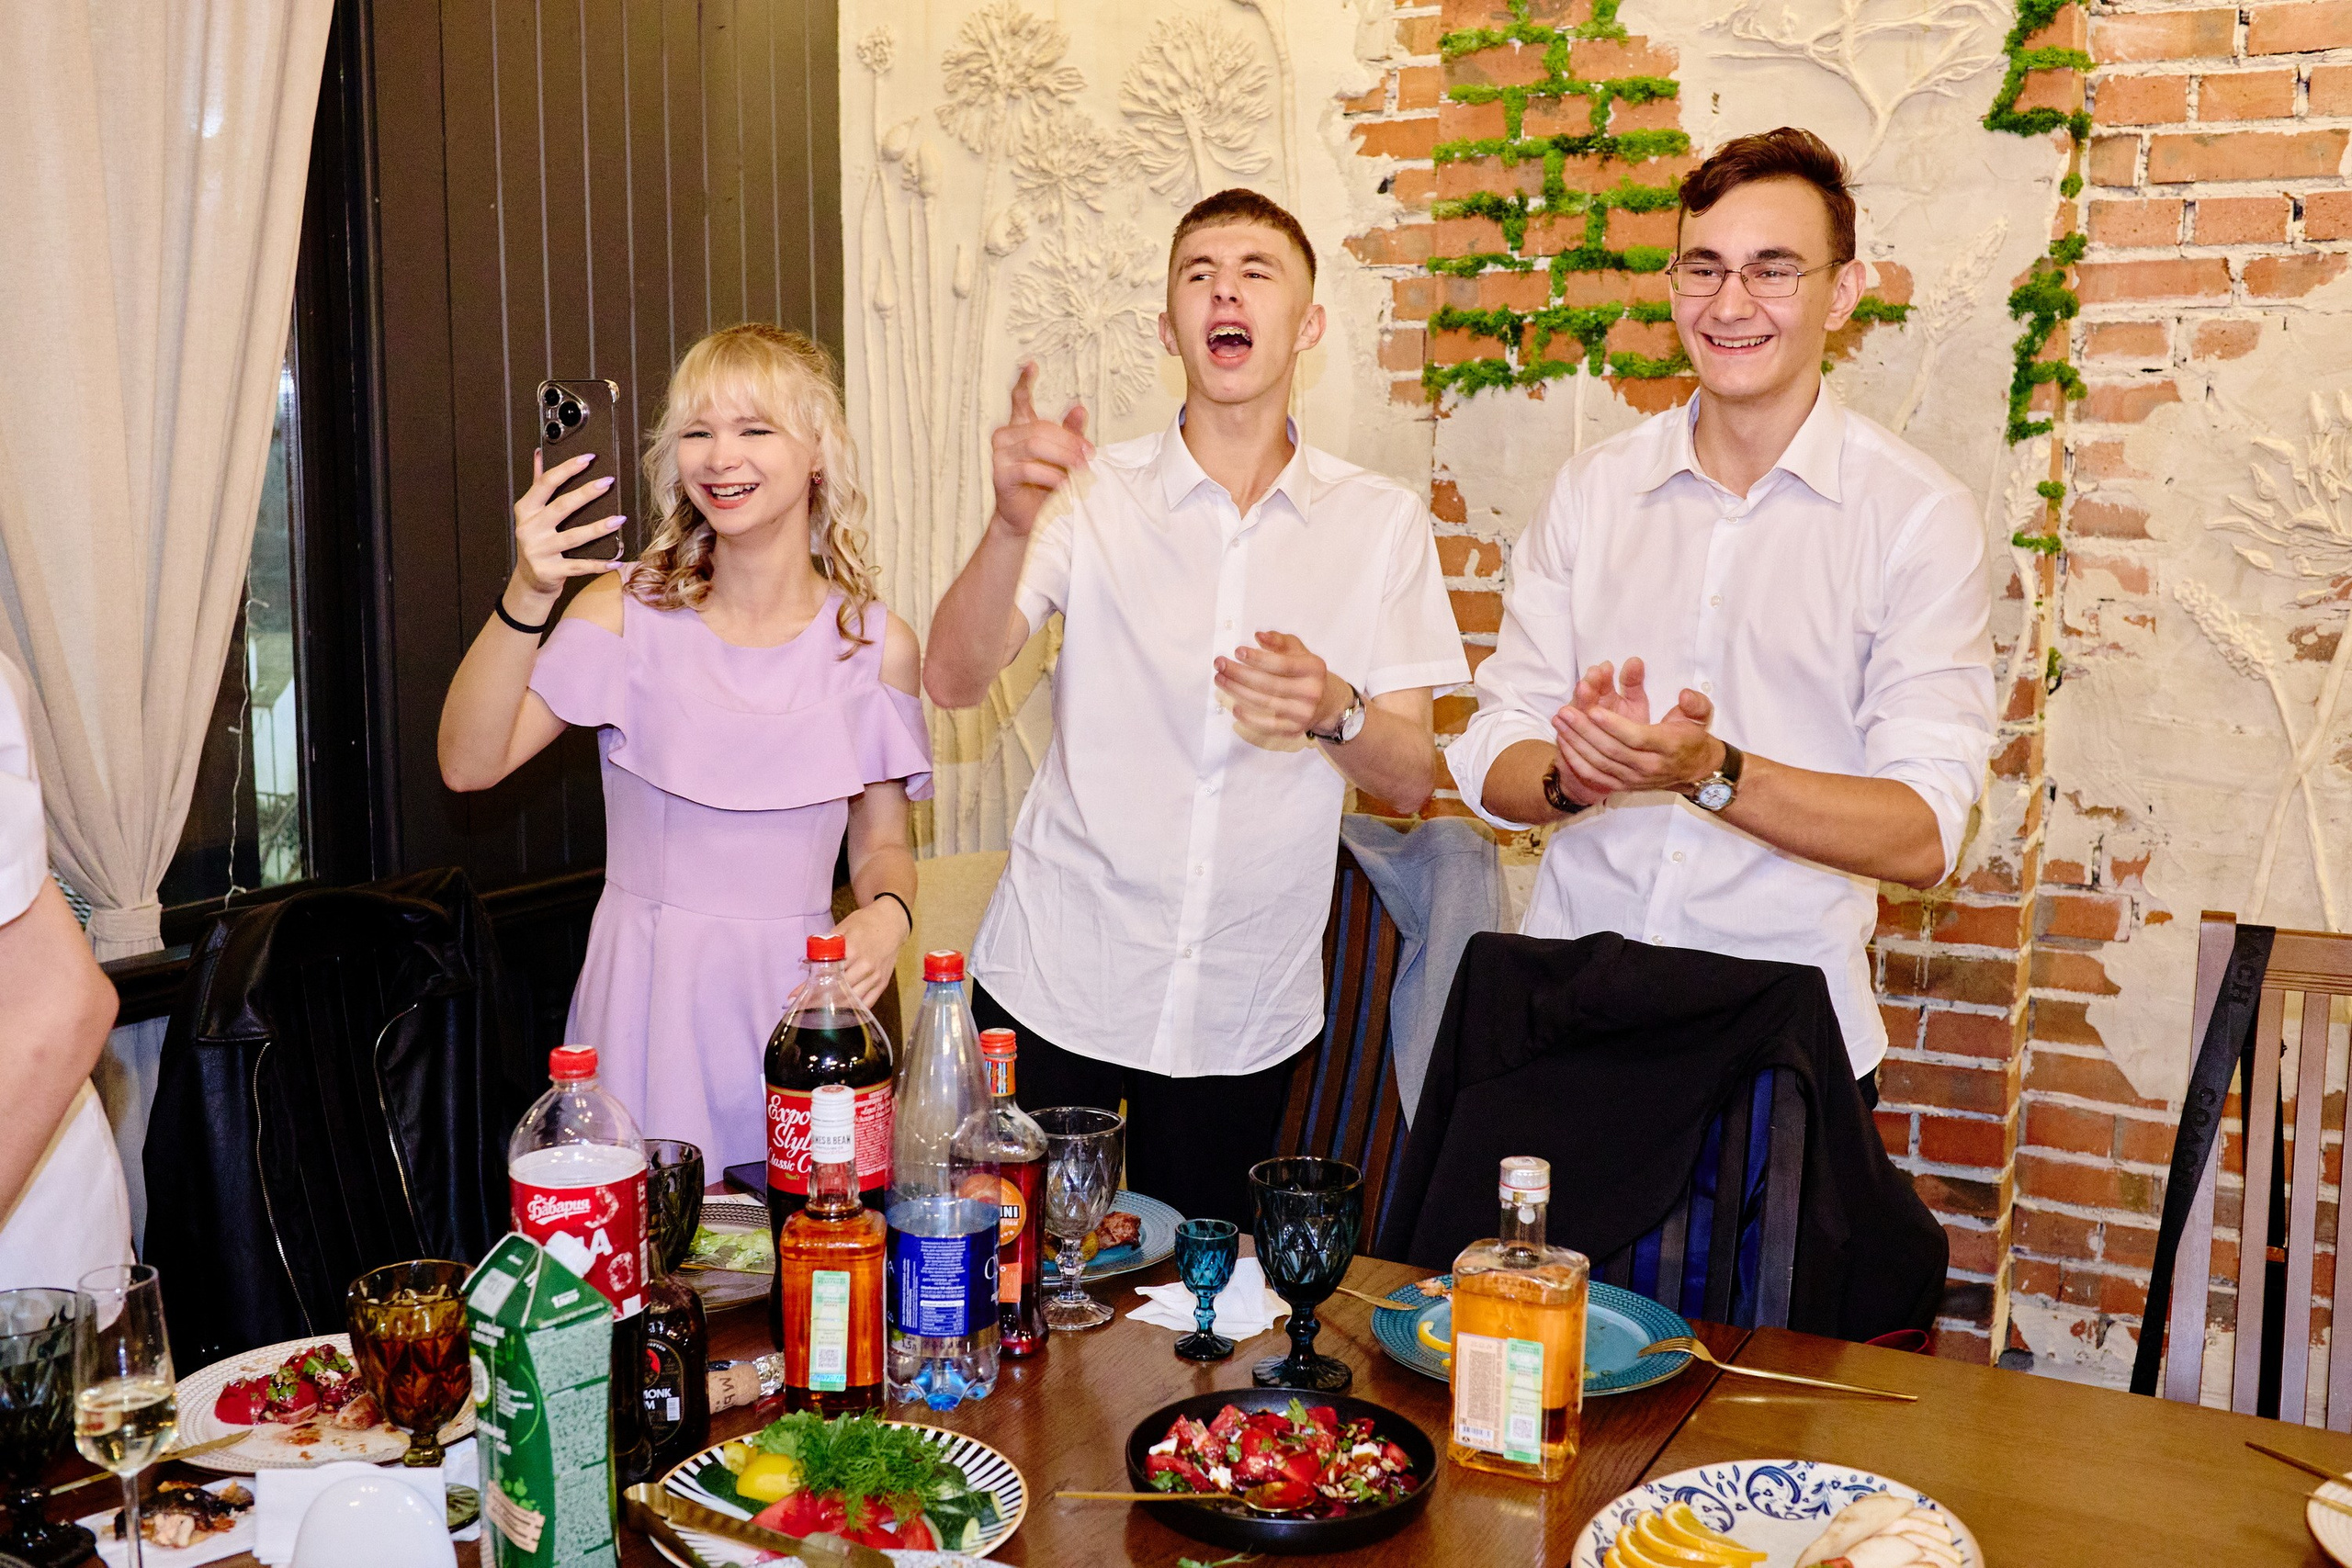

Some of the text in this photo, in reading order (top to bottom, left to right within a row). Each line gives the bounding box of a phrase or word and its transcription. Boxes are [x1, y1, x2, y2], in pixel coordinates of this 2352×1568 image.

[767, 1094, 811, 1134] Expo
[773, 1123, 812, 1158] Styl
[526, 1194, 592, 1223] Бавария
